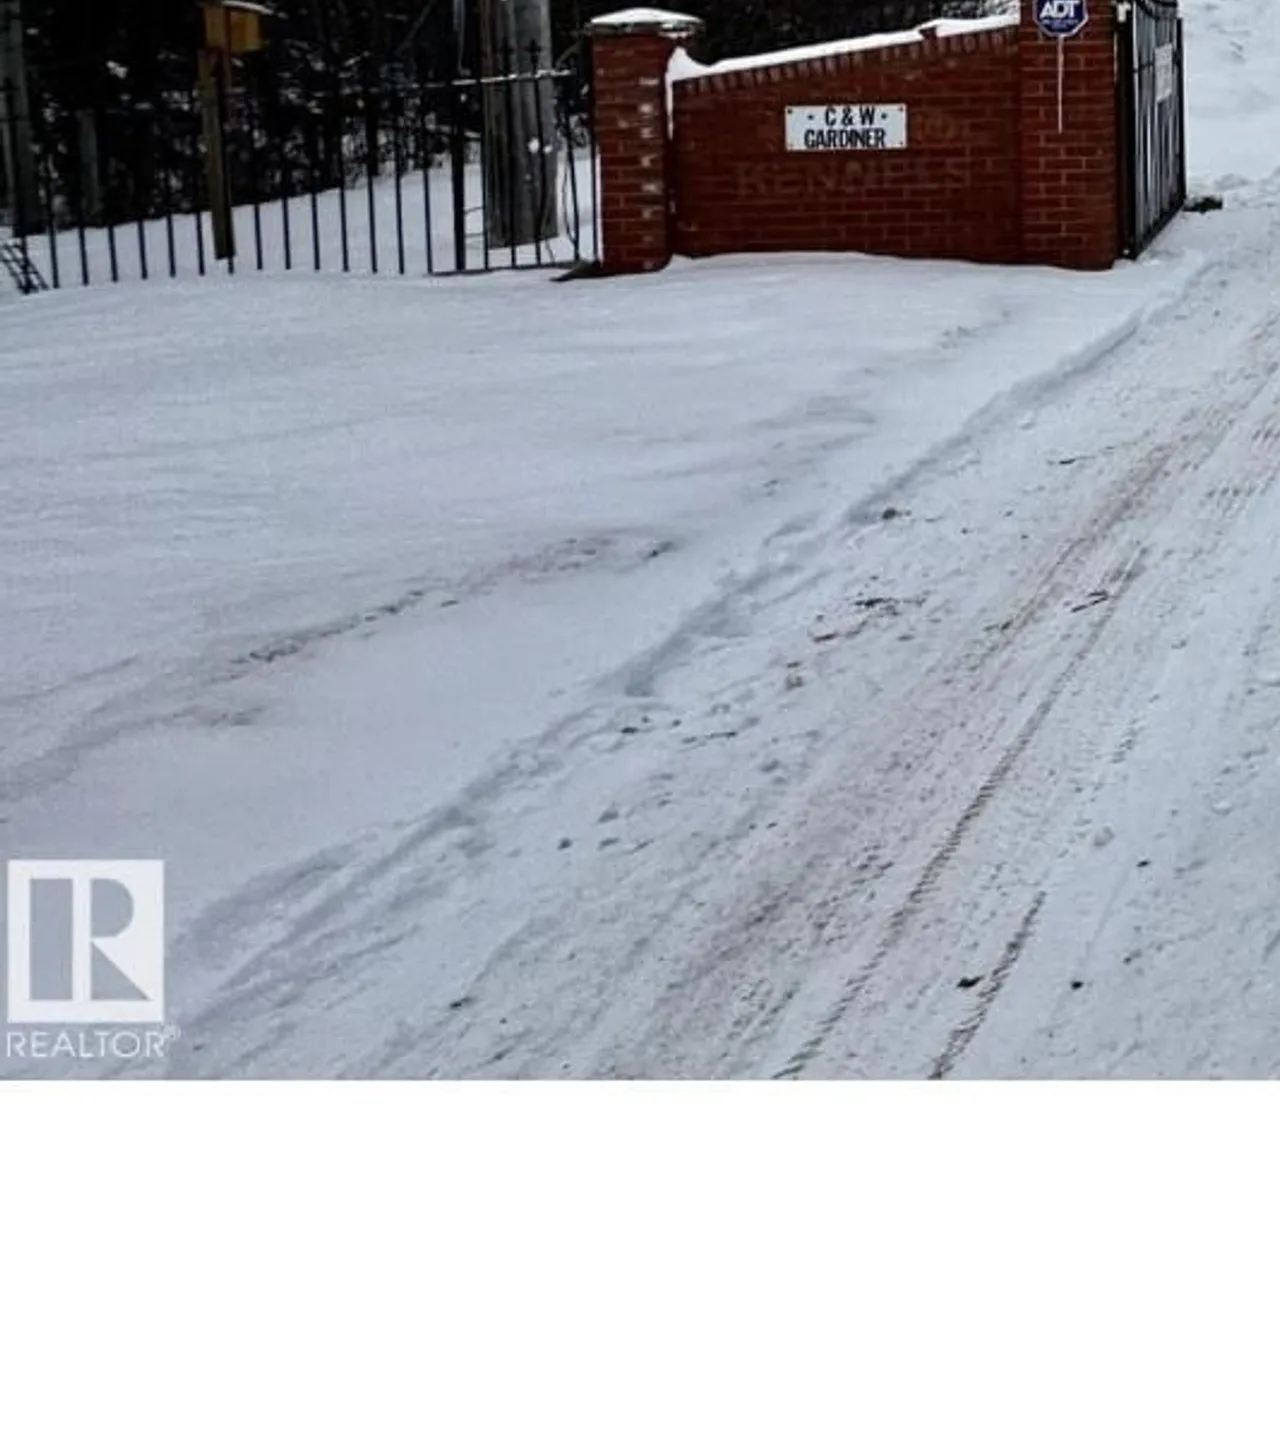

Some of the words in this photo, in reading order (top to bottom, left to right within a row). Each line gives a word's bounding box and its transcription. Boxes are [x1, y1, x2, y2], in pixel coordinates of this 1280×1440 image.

[1040, 0, 1080, 19] ADT
[825, 107, 837, 126] C
[842, 106, 853, 126] &
[859, 106, 875, 126] W
